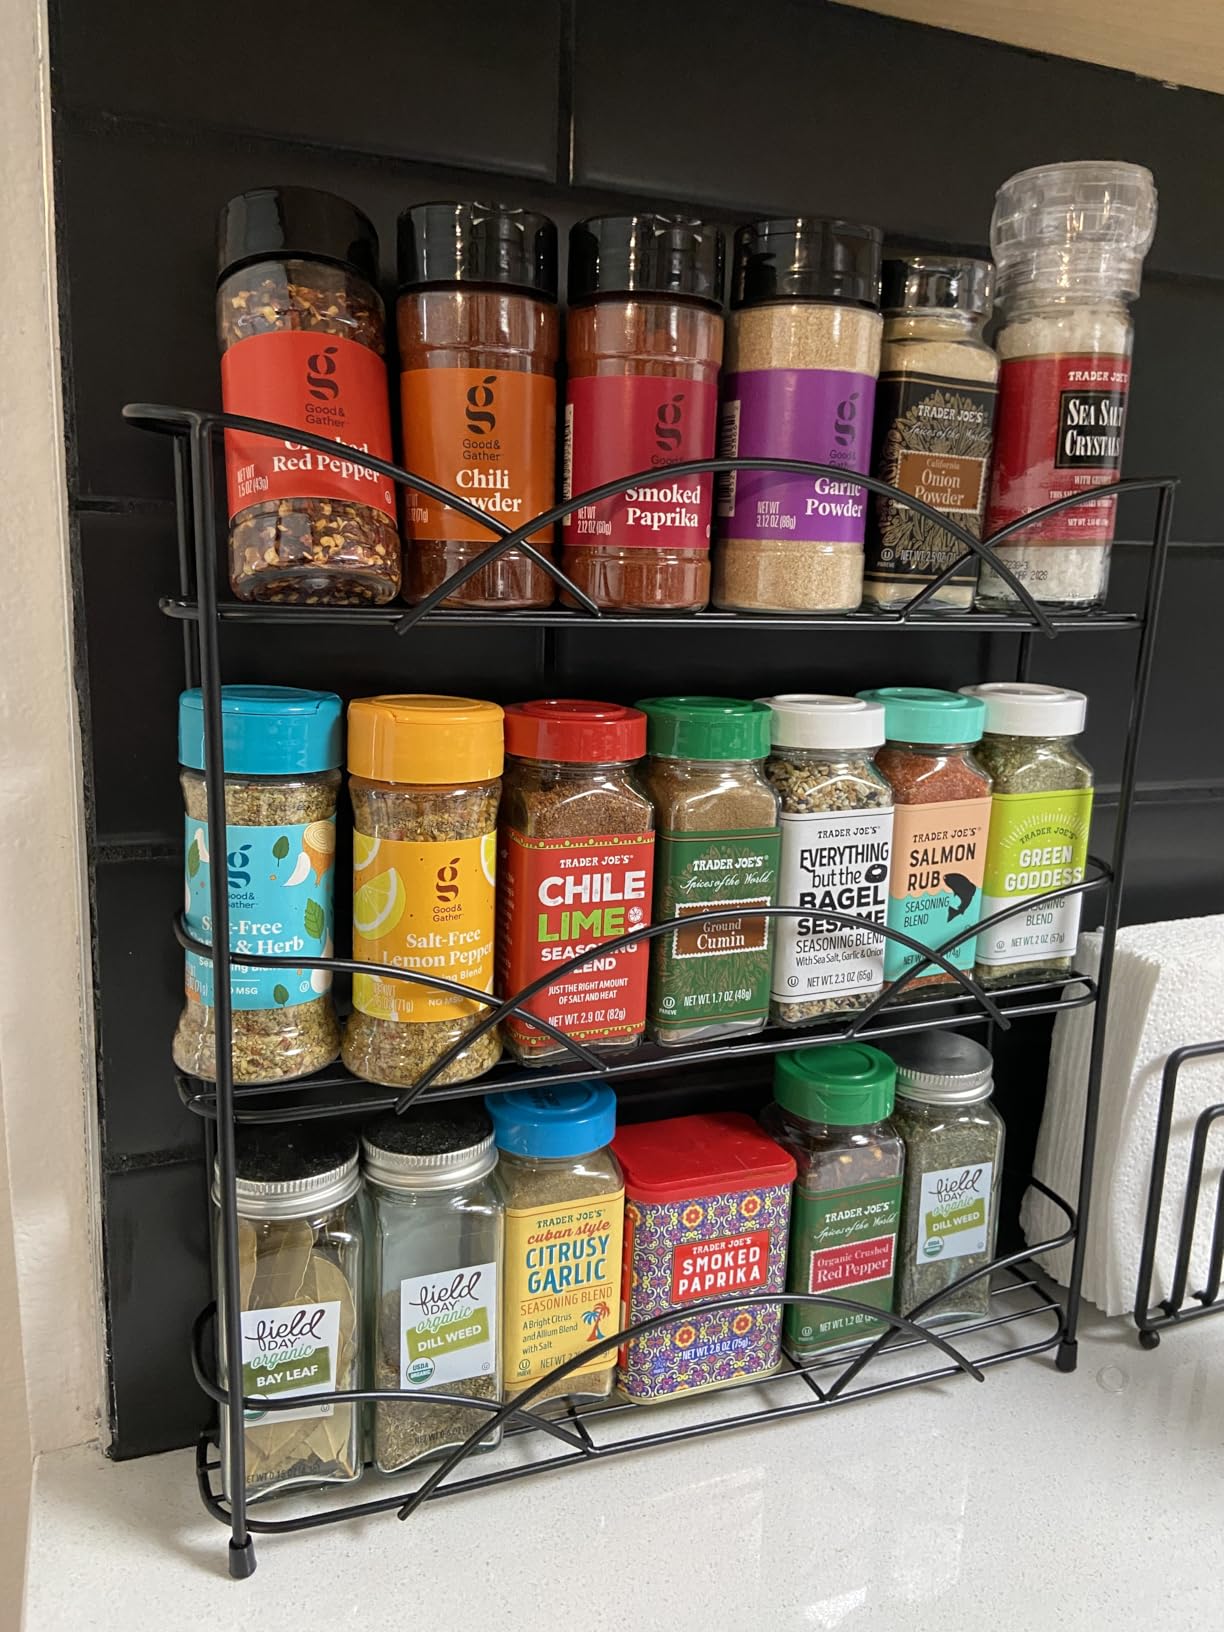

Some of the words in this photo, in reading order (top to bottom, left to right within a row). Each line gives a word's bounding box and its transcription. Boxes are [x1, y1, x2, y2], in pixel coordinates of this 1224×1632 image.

[1068, 371, 1109, 382] TRADER
[305, 415, 344, 427] Gather
[918, 404, 956, 420] TRADER
[956, 410, 984, 423] JOE'S
[462, 450, 500, 461] Gather
[926, 458, 960, 470] California
[272, 453, 312, 472] Red
[316, 455, 380, 483] Pepper
[456, 468, 510, 489] Chili
[922, 470, 960, 488] Onion
[625, 484, 700, 504] Smoked
[914, 486, 964, 506] Powder
[758, 502, 769, 514] NET
[770, 502, 780, 514] WT
[805, 498, 862, 518] Powder
[626, 508, 698, 530] Paprika
[756, 515, 769, 528] 3.12
[770, 515, 778, 528] OZ
[817, 829, 851, 839] TRADER
[853, 827, 878, 836] JOE'S
[913, 831, 948, 843] TRADER
[951, 828, 976, 838] JOE'S
[1019, 827, 1052, 844] TRADER
[1054, 827, 1077, 840] JOE'S
[560, 858, 599, 868] TRADER
[601, 855, 629, 866] JOE'S
[692, 859, 733, 871] TRADER
[735, 856, 763, 868] JOE'S
[800, 842, 888, 869] EVERYTHING
[909, 843, 976, 867] SALMON
[1019, 845, 1073, 868] GREEN
[680, 878, 714, 894] Spices
[714, 875, 729, 892] of
[726, 874, 740, 886] the
[744, 870, 774, 884] World
[812, 867, 838, 888] but
[838, 865, 861, 885] the
[907, 870, 940, 891] RUB
[1004, 867, 1083, 892] GODDESS
[538, 870, 646, 907] CHILE
[800, 885, 885, 911] BAGEL
[905, 896, 950, 914] SEASONING
[432, 913, 462, 922] Gather
[538, 907, 625, 942] LIME
[703, 918, 742, 932] Ground
[904, 914, 929, 928] BLEND
[1026, 912, 1053, 926] BLEND
[256, 936, 304, 955] Herb
[406, 930, 480, 949] Salt-Free
[696, 932, 745, 950] Cumin
[796, 935, 853, 954] SEASONING
[856, 931, 883, 946] BLEND
[1011, 938, 1022, 947] NET
[1035, 936, 1039, 944] 2
[1041, 935, 1048, 944] OZ
[384, 951, 445, 968] Lemon
[450, 942, 492, 966] Pepper
[796, 956, 812, 966] With
[813, 955, 825, 964] Sea
[842, 951, 859, 960] Garlic
[866, 948, 883, 957] Onion
[460, 966, 482, 980] Blend
[807, 977, 820, 988] NET
[821, 975, 833, 986] WT.
[834, 973, 845, 984] 2.3
[846, 972, 855, 982] OZ
[857, 970, 873, 982] (65g)
[236, 987, 258, 995] MSG
[548, 985, 566, 996] JUST
[565, 984, 578, 992] THE
[578, 982, 598, 991] RIGHT
[599, 978, 628, 989] AMOUNT
[558, 996, 568, 1005] OF
[569, 995, 585, 1004] SALT
[585, 992, 599, 1001] AND
[600, 990, 617, 1000] HEAT
[684, 995, 697, 1007] NET
[698, 994, 710, 1004] WT.
[713, 992, 722, 1003] 1.7
[724, 991, 733, 1002] OZ
[735, 988, 752, 1002] (48g)
[548, 1016, 564, 1027] NET
[565, 1013, 579, 1025] WT.
[580, 1012, 593, 1024] 2.9
[595, 1010, 605, 1022] OZ
[607, 1008, 626, 1021] (82g)
[928, 1168, 983, 1203] field
[944, 1191, 964, 1202] DAY
[825, 1206, 862, 1223] TRADER
[864, 1202, 890, 1214] JOE'S
[933, 1196, 974, 1217] organic
[536, 1216, 573, 1228] TRADER
[576, 1210, 602, 1220] JOE'S
[814, 1227, 844, 1243] Spices
[854, 1220, 869, 1232] the
[872, 1211, 898, 1227] World
[932, 1221, 952, 1232] DILL
[953, 1212, 980, 1225] WEED
[527, 1227, 573, 1245] cuban
[575, 1220, 610, 1238] style
[526, 1234, 610, 1270] CITRUSY
[692, 1242, 726, 1255] TRADER
[728, 1237, 752, 1248] JOE'S
[682, 1247, 760, 1275] SMOKED
[817, 1254, 851, 1269] Organic
[854, 1244, 889, 1259] Crushed
[528, 1259, 607, 1294] GARLIC
[816, 1267, 842, 1284] Red
[845, 1259, 888, 1277] Pepper
[678, 1269, 760, 1295] PAPRIKA
[409, 1271, 482, 1316] field
[520, 1293, 578, 1316] SEASONING
[581, 1287, 612, 1303] BLEND
[430, 1302, 458, 1315] DAY
[417, 1306, 472, 1332] organic
[523, 1323, 528, 1331] A
[529, 1318, 550, 1329] Bright
[551, 1313, 572, 1324] Citrus
[820, 1322, 831, 1332] NET
[845, 1316, 854, 1326] 1.2
[855, 1314, 864, 1324] OZ
[245, 1309, 325, 1351] field
[418, 1337, 444, 1352] DILL
[446, 1324, 482, 1344] WEED
[523, 1334, 536, 1342] and
[537, 1328, 558, 1340] Allium
[559, 1324, 578, 1334] Blend
[268, 1338, 297, 1350] DAY
[523, 1345, 538, 1355] with
[540, 1341, 552, 1350] Salt
[682, 1350, 696, 1360] NET
[722, 1342, 731, 1351] OZ
[252, 1345, 314, 1370] organic
[412, 1362, 428, 1370] USDA
[540, 1357, 554, 1368] NET
[256, 1374, 282, 1387] BAY
[286, 1365, 318, 1382] LEAF
